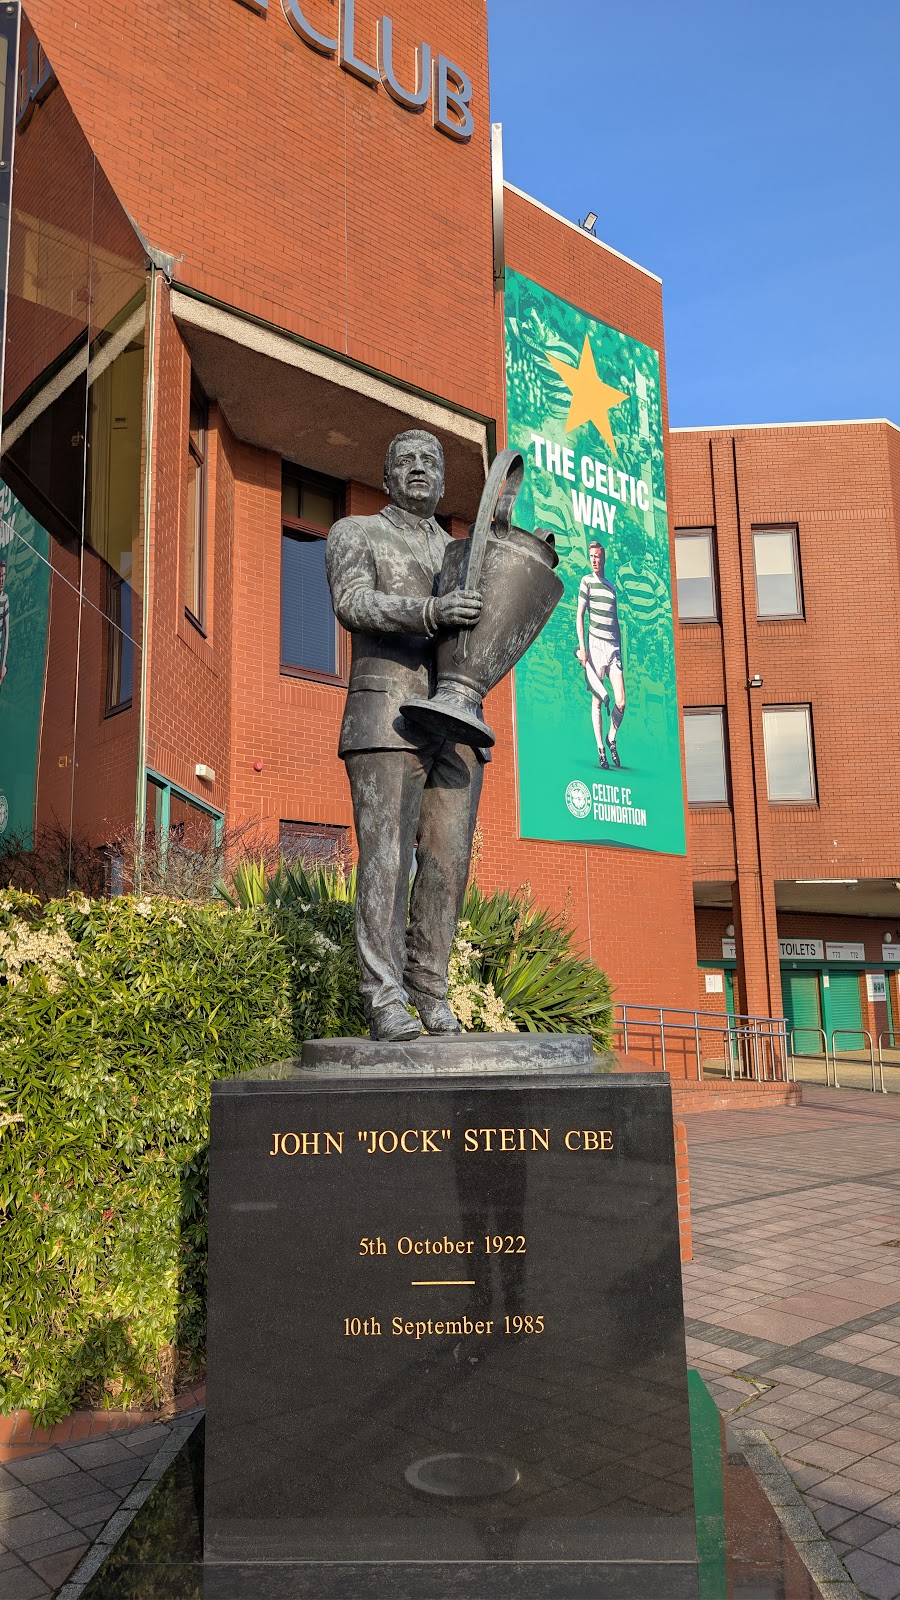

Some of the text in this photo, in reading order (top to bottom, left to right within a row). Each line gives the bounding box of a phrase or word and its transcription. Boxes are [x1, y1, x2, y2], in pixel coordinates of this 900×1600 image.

[281, 0, 475, 138] CLUB
[530, 433, 650, 512] THE CELTIC
[571, 488, 617, 535] WAY
[592, 783, 620, 804] CELTIC
[621, 787, 632, 806] FC
[593, 802, 647, 826] FOUNDATION
[780, 942, 816, 956] TOILETS
[270, 1128, 615, 1156] JOHN "JOCK" STEIN CBE
[359, 1235, 527, 1256] 5th October 1922
[343, 1315, 545, 1340] 10th September 1985
